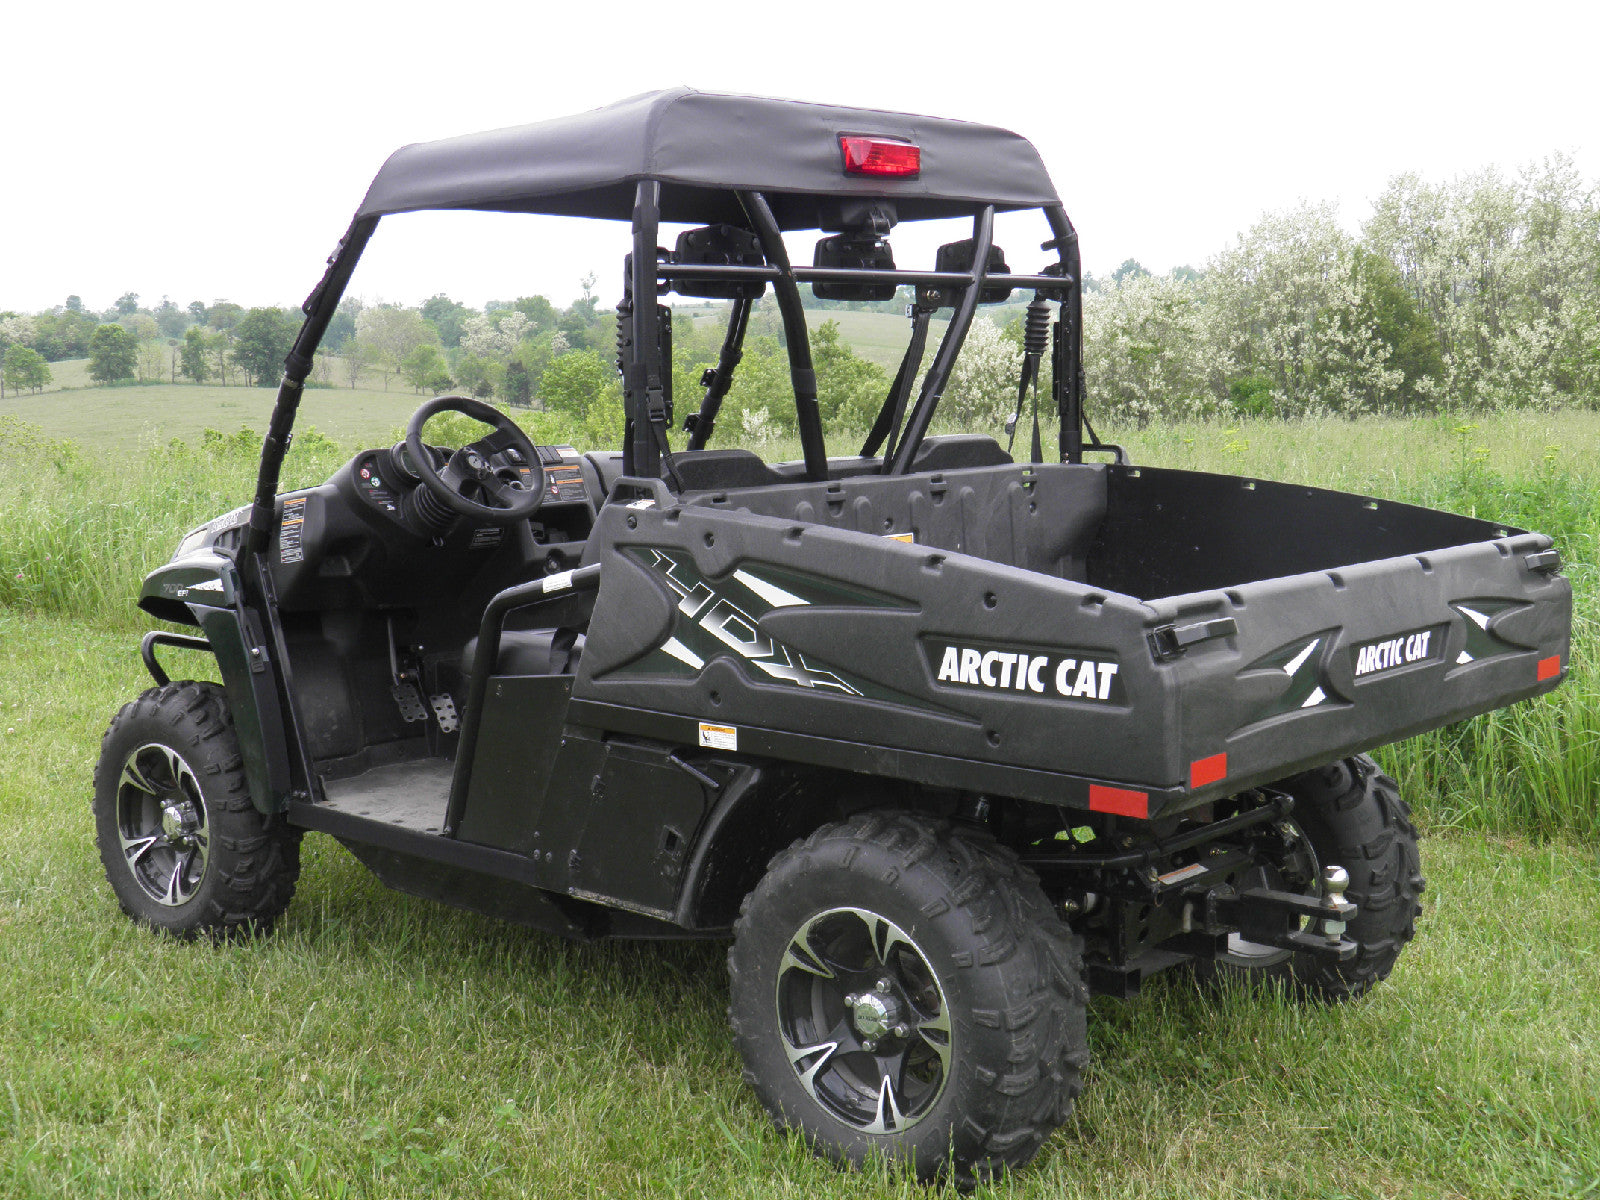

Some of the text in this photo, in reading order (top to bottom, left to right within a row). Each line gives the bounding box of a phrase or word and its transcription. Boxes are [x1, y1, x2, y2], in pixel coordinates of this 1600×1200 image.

[937, 646, 1119, 700] ARCTIC CAT
[1355, 630, 1431, 676] ARCTIC CAT
